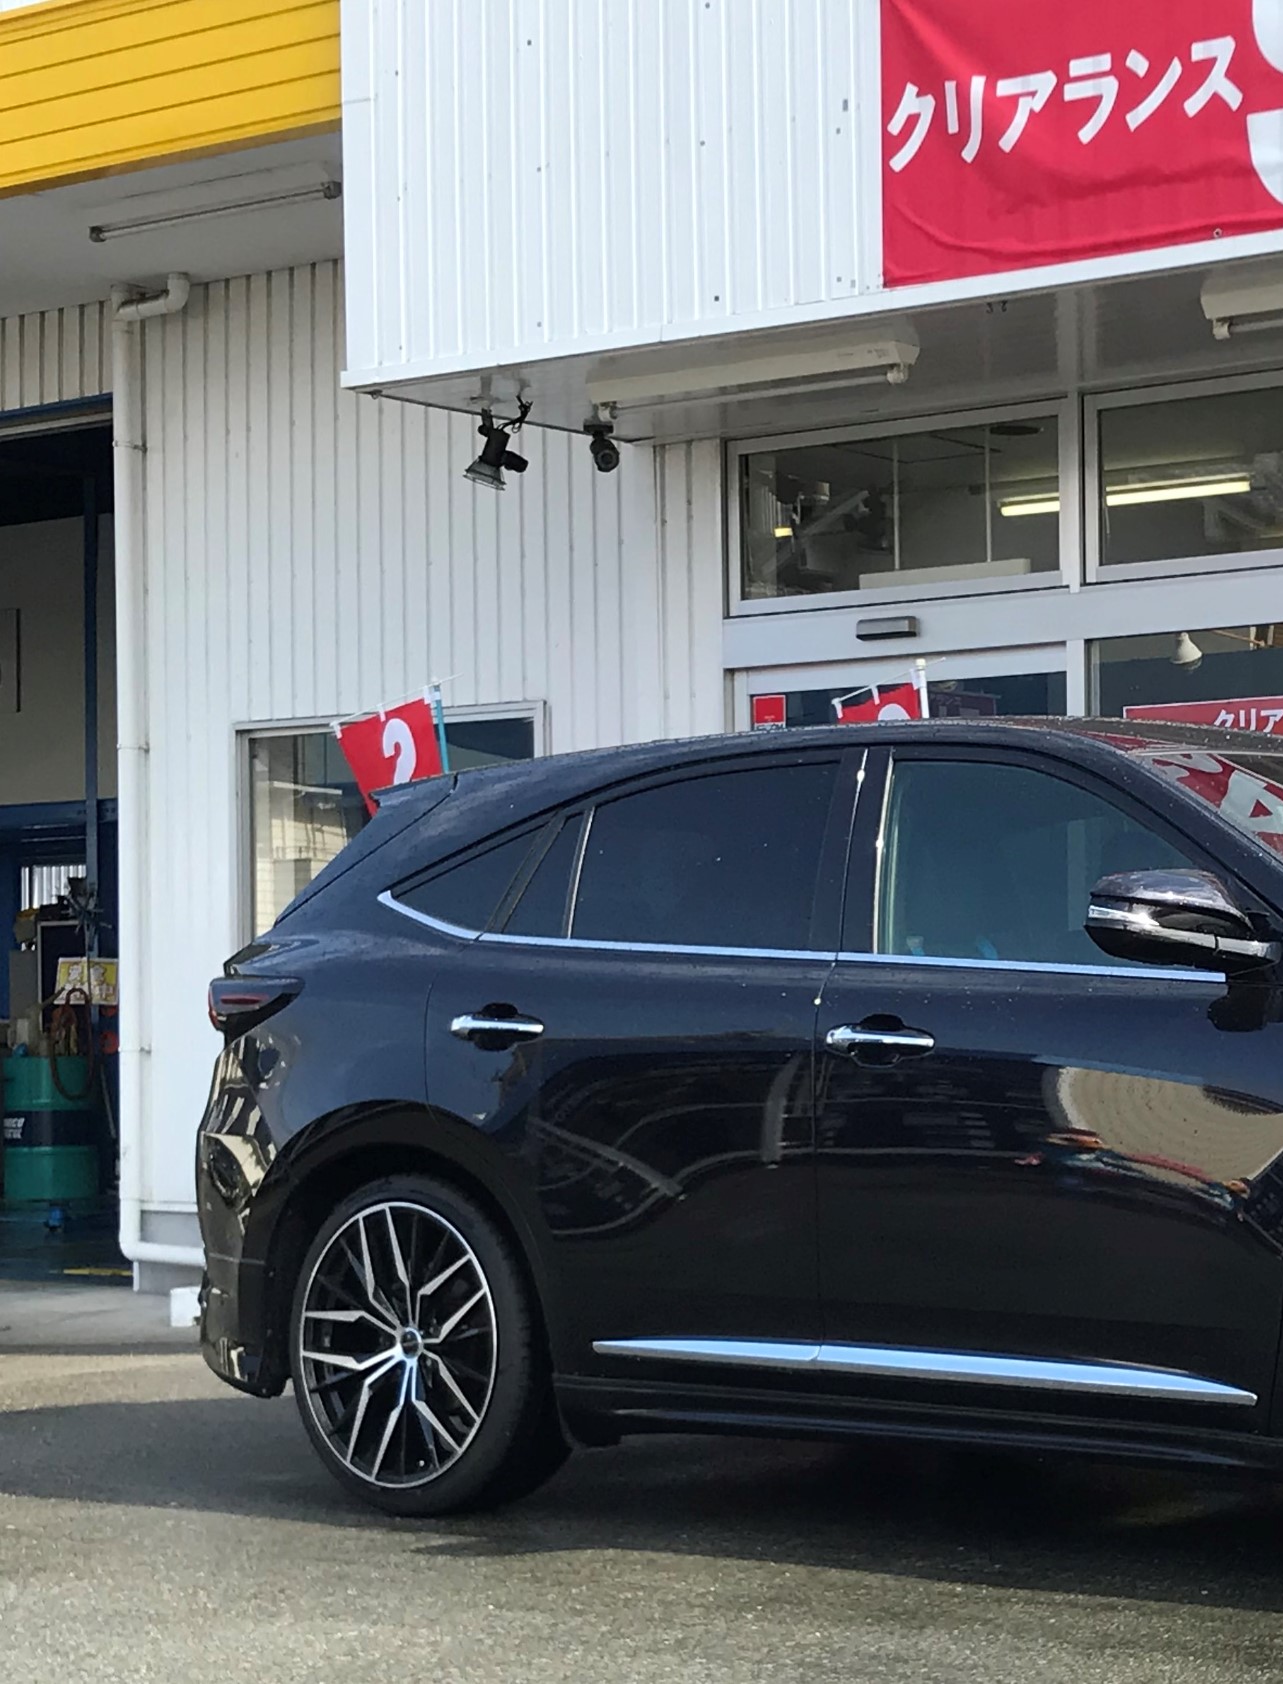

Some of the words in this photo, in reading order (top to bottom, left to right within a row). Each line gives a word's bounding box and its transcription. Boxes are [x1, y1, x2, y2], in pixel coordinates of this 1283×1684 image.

[888, 35, 1243, 172] クリアランス
